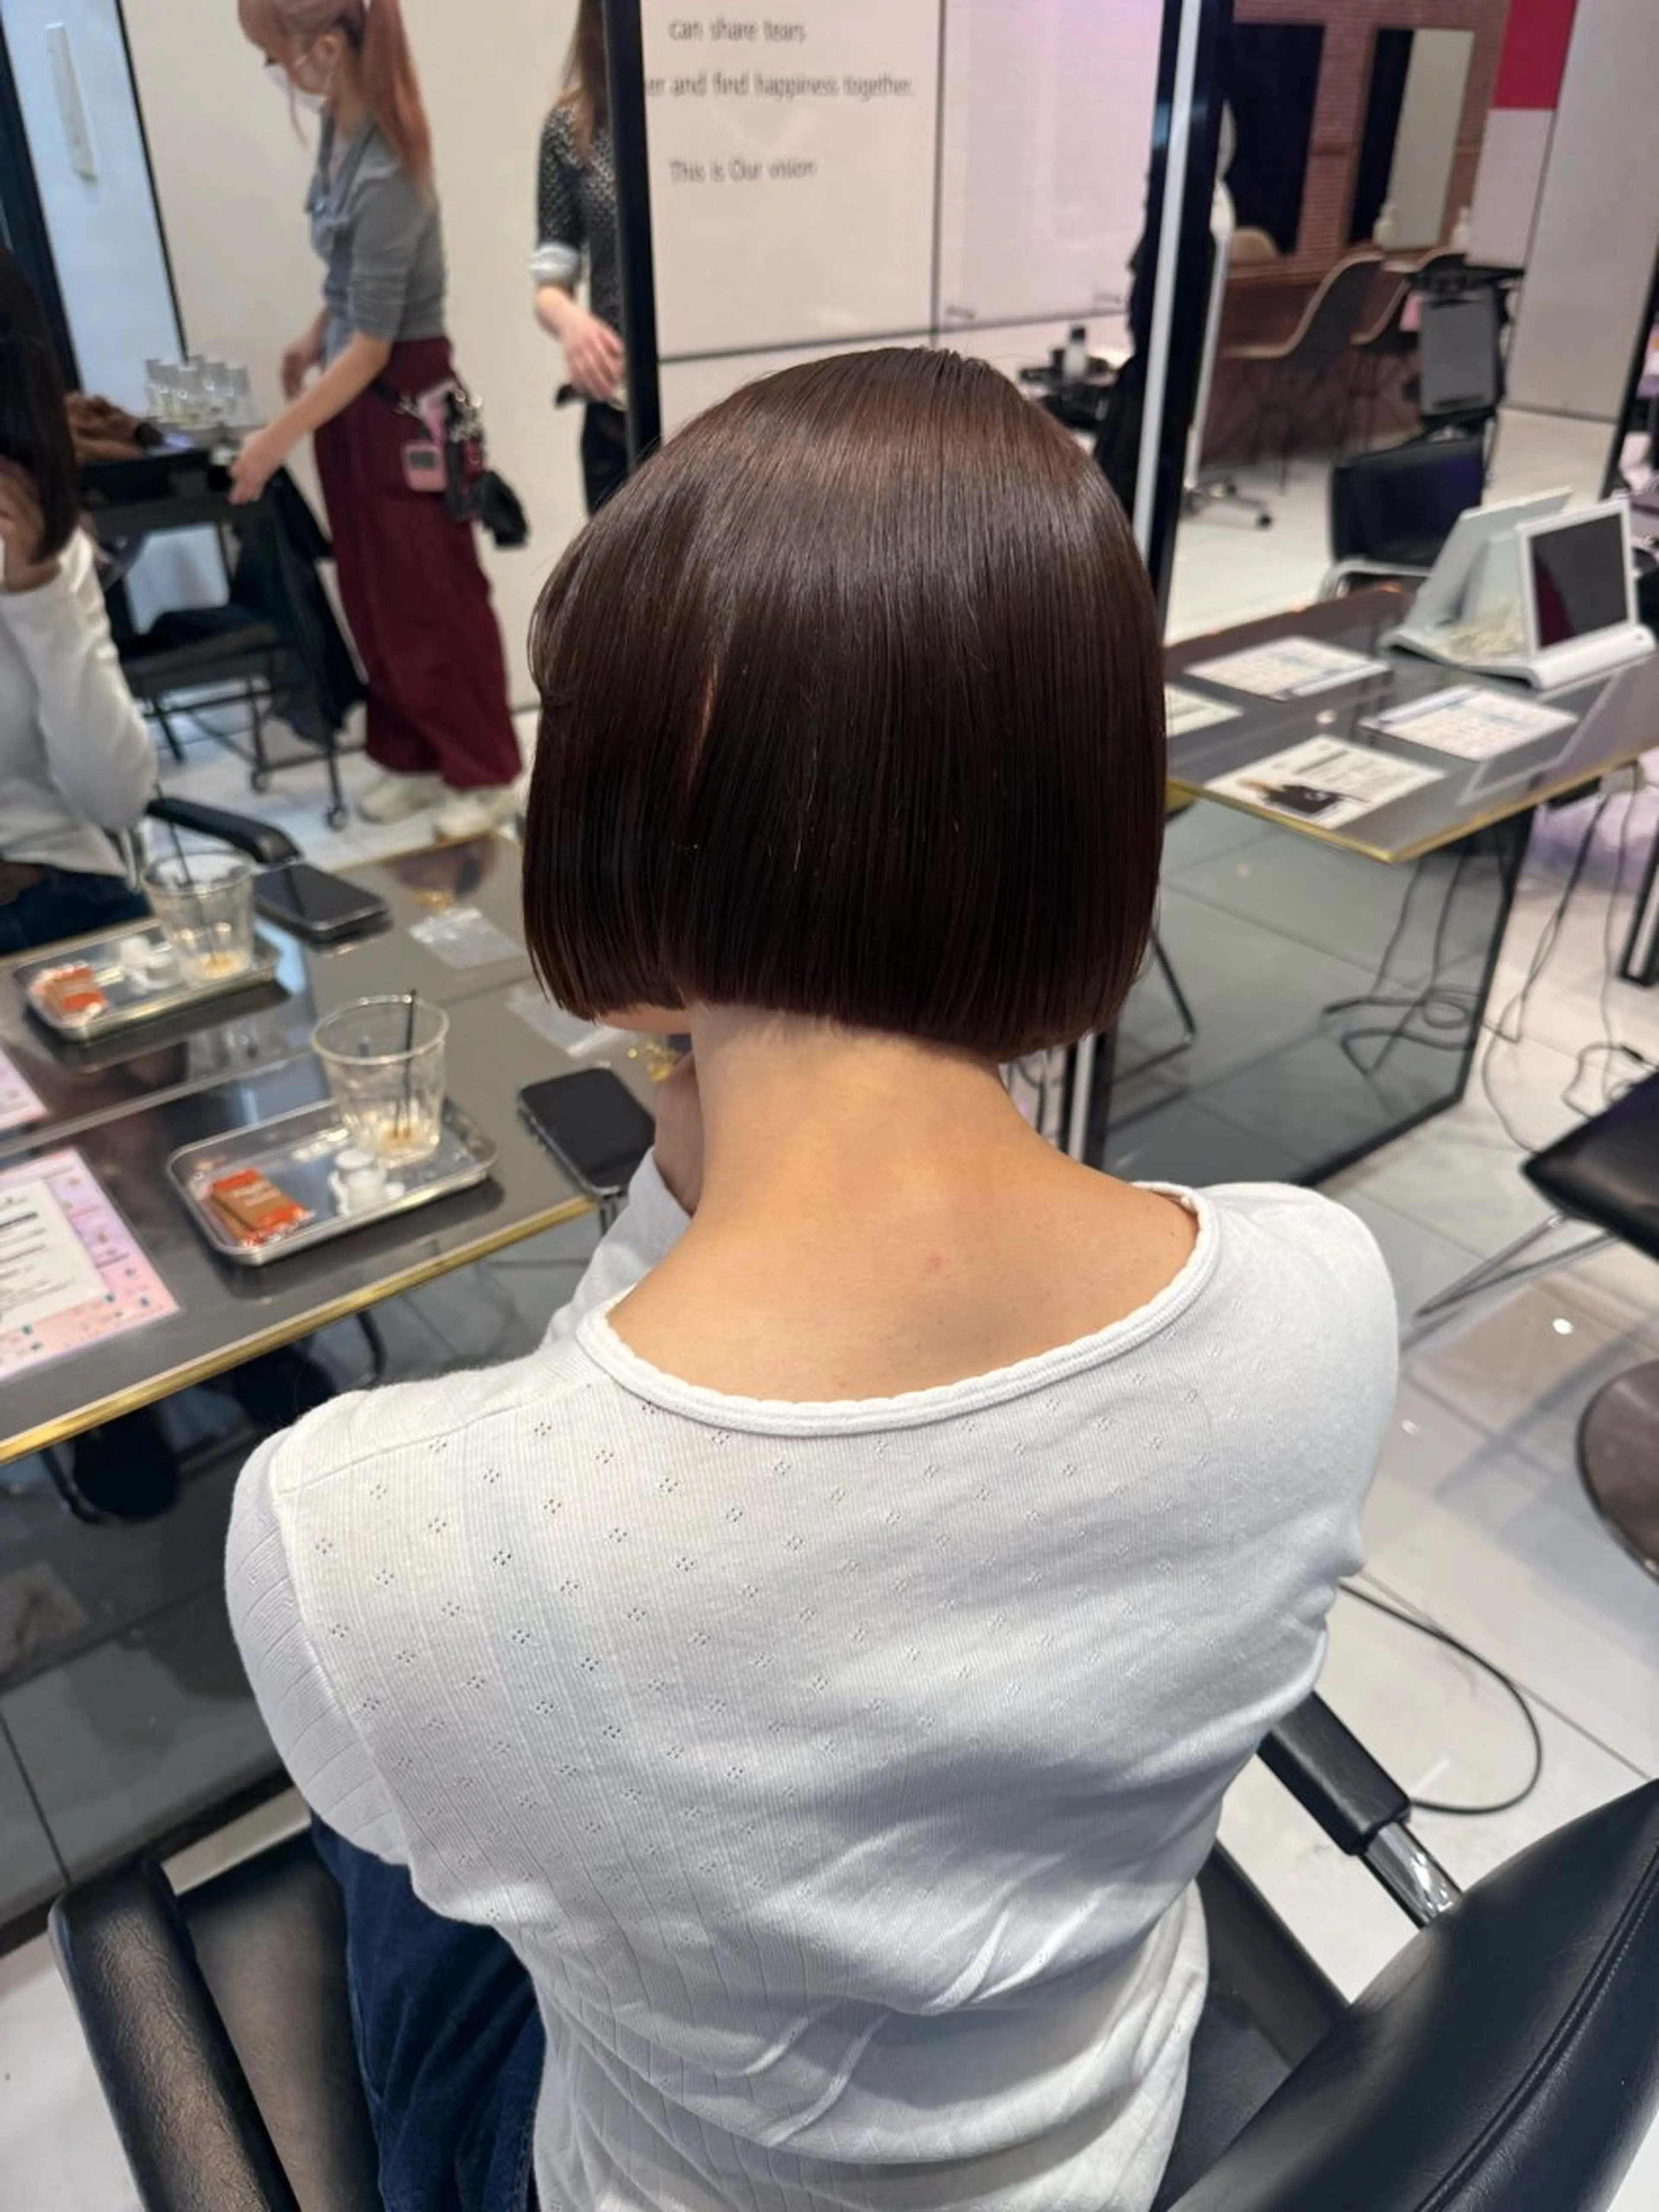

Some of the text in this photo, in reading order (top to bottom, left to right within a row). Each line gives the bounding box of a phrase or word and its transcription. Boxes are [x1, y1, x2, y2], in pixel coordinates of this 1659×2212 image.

[667, 16, 807, 43] can share tears
[669, 72, 707, 96] and
[712, 70, 748, 96] find
[754, 72, 839, 101] happiness
[669, 156, 815, 183] This is Our vision
